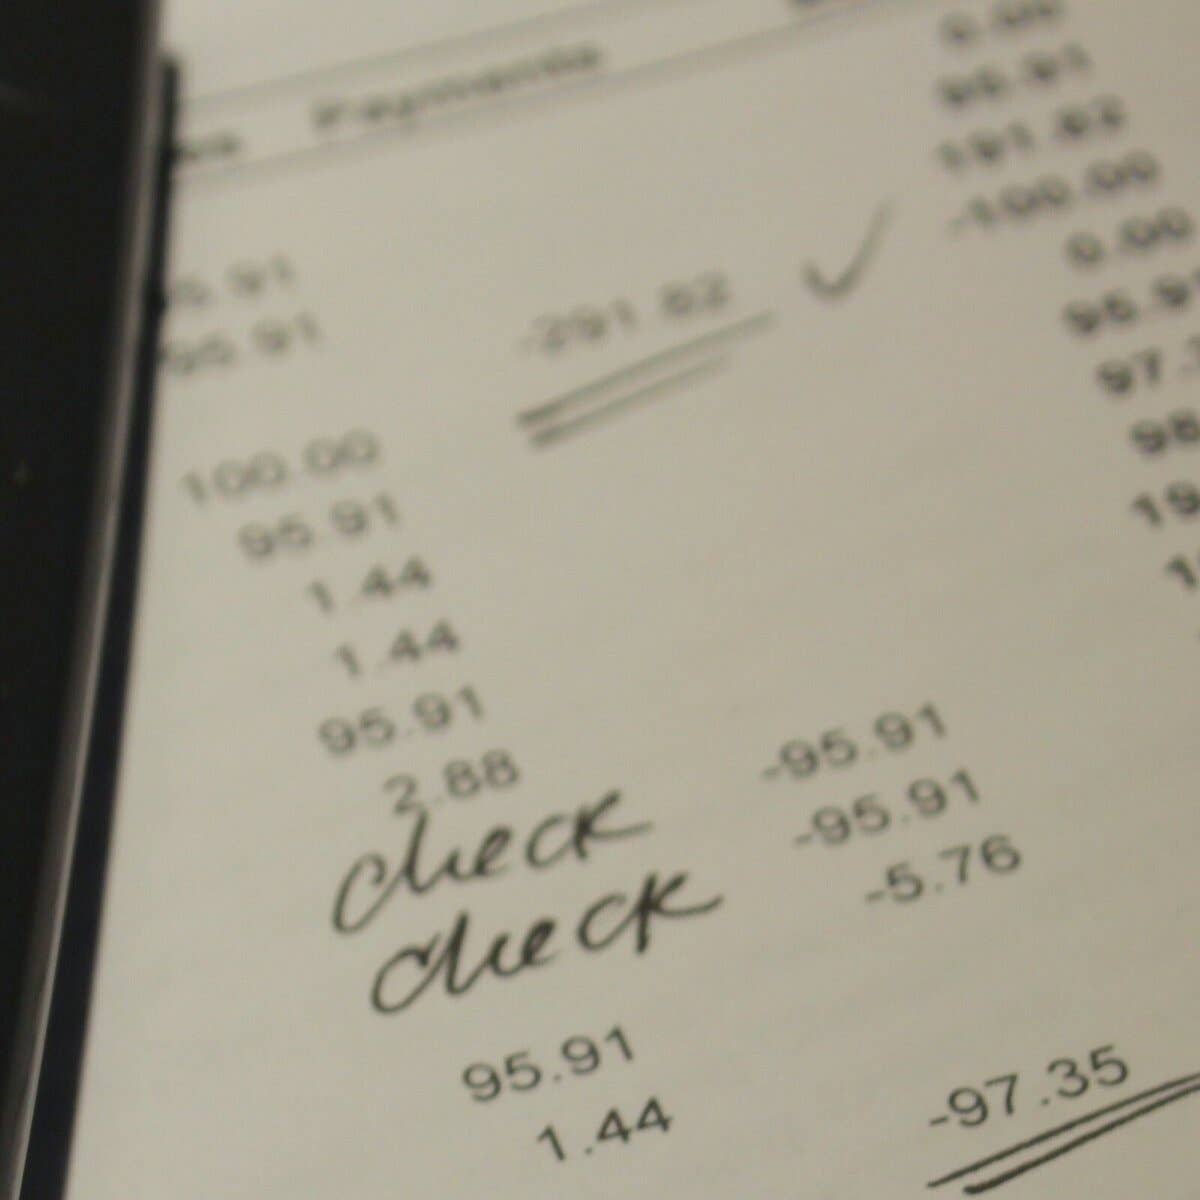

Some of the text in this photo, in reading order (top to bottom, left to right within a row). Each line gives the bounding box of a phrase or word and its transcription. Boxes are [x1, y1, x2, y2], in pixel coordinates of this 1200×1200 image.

[180, 429, 381, 504] 100.00
[238, 492, 401, 562] 95.91
[307, 554, 433, 614] 1.44
[334, 618, 462, 677] 1.44
[318, 684, 484, 757] 95.91
[760, 701, 947, 780] -95.91
[794, 768, 980, 847] -95.91
[331, 790, 654, 935] check
[864, 834, 1023, 905] -5.76
[370, 871, 725, 1016] check
[462, 1025, 635, 1103] 95.91
[928, 1044, 1129, 1128] -97.35
[537, 1096, 673, 1163] 1.44
